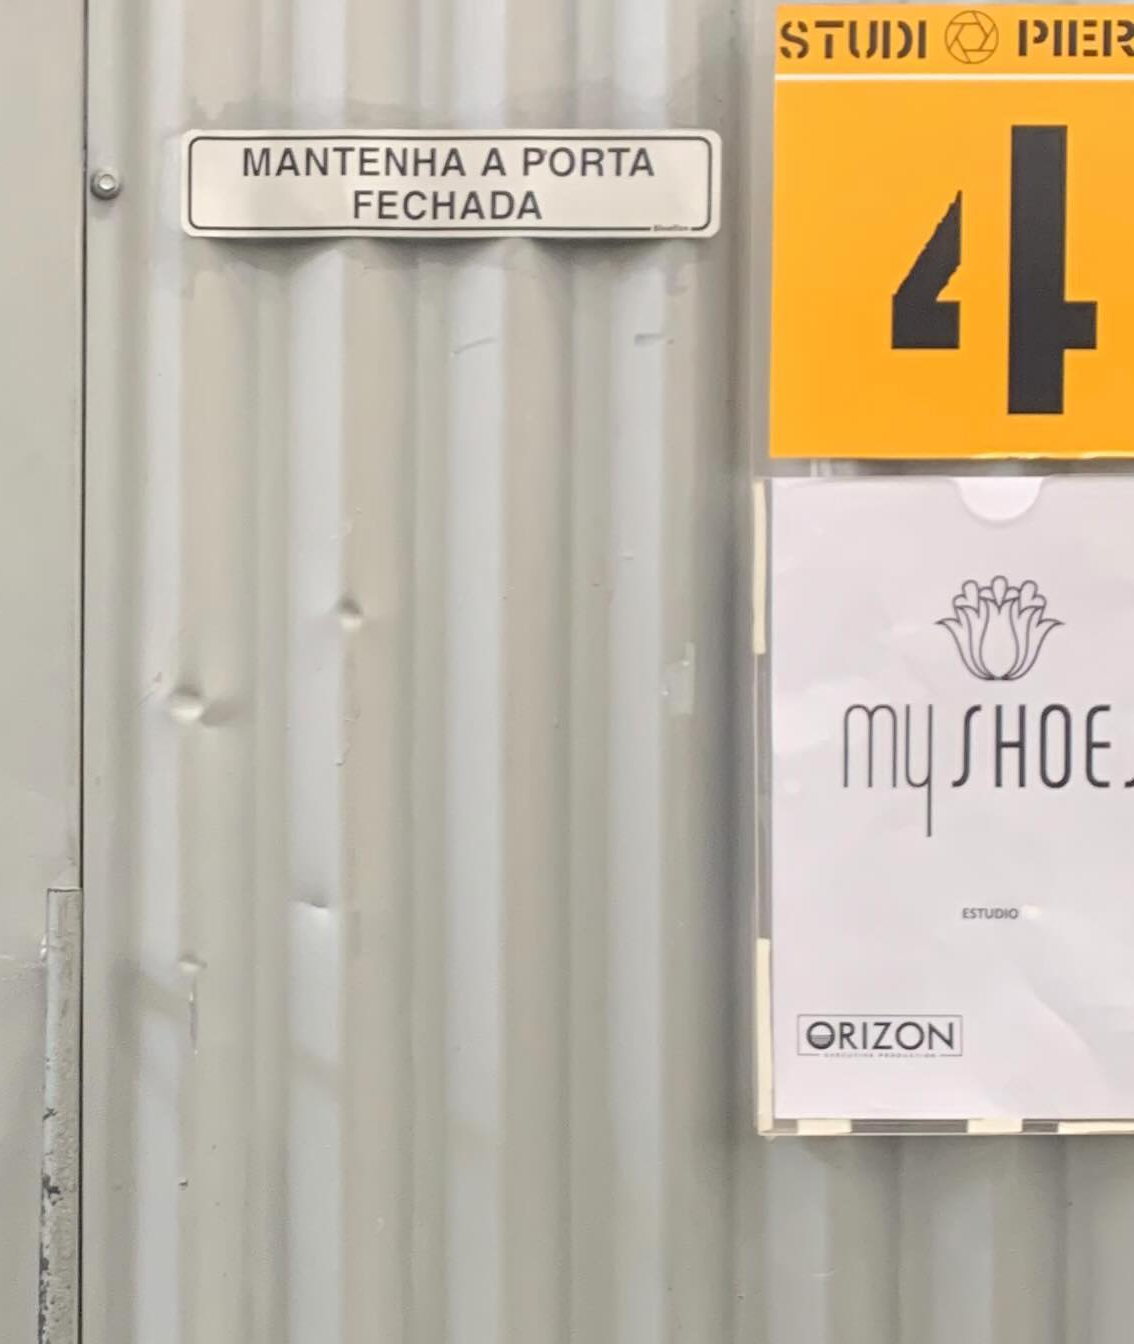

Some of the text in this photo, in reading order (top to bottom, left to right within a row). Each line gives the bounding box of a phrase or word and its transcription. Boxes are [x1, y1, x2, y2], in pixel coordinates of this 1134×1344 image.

[242, 146, 655, 177] MANTENHA A PORTA
[353, 190, 543, 220] FECHADA
[892, 124, 1097, 415] 4
[951, 703, 1134, 789] SHOE
[961, 907, 1020, 920] ESTUDIO
[806, 1020, 954, 1051] ORIZON
